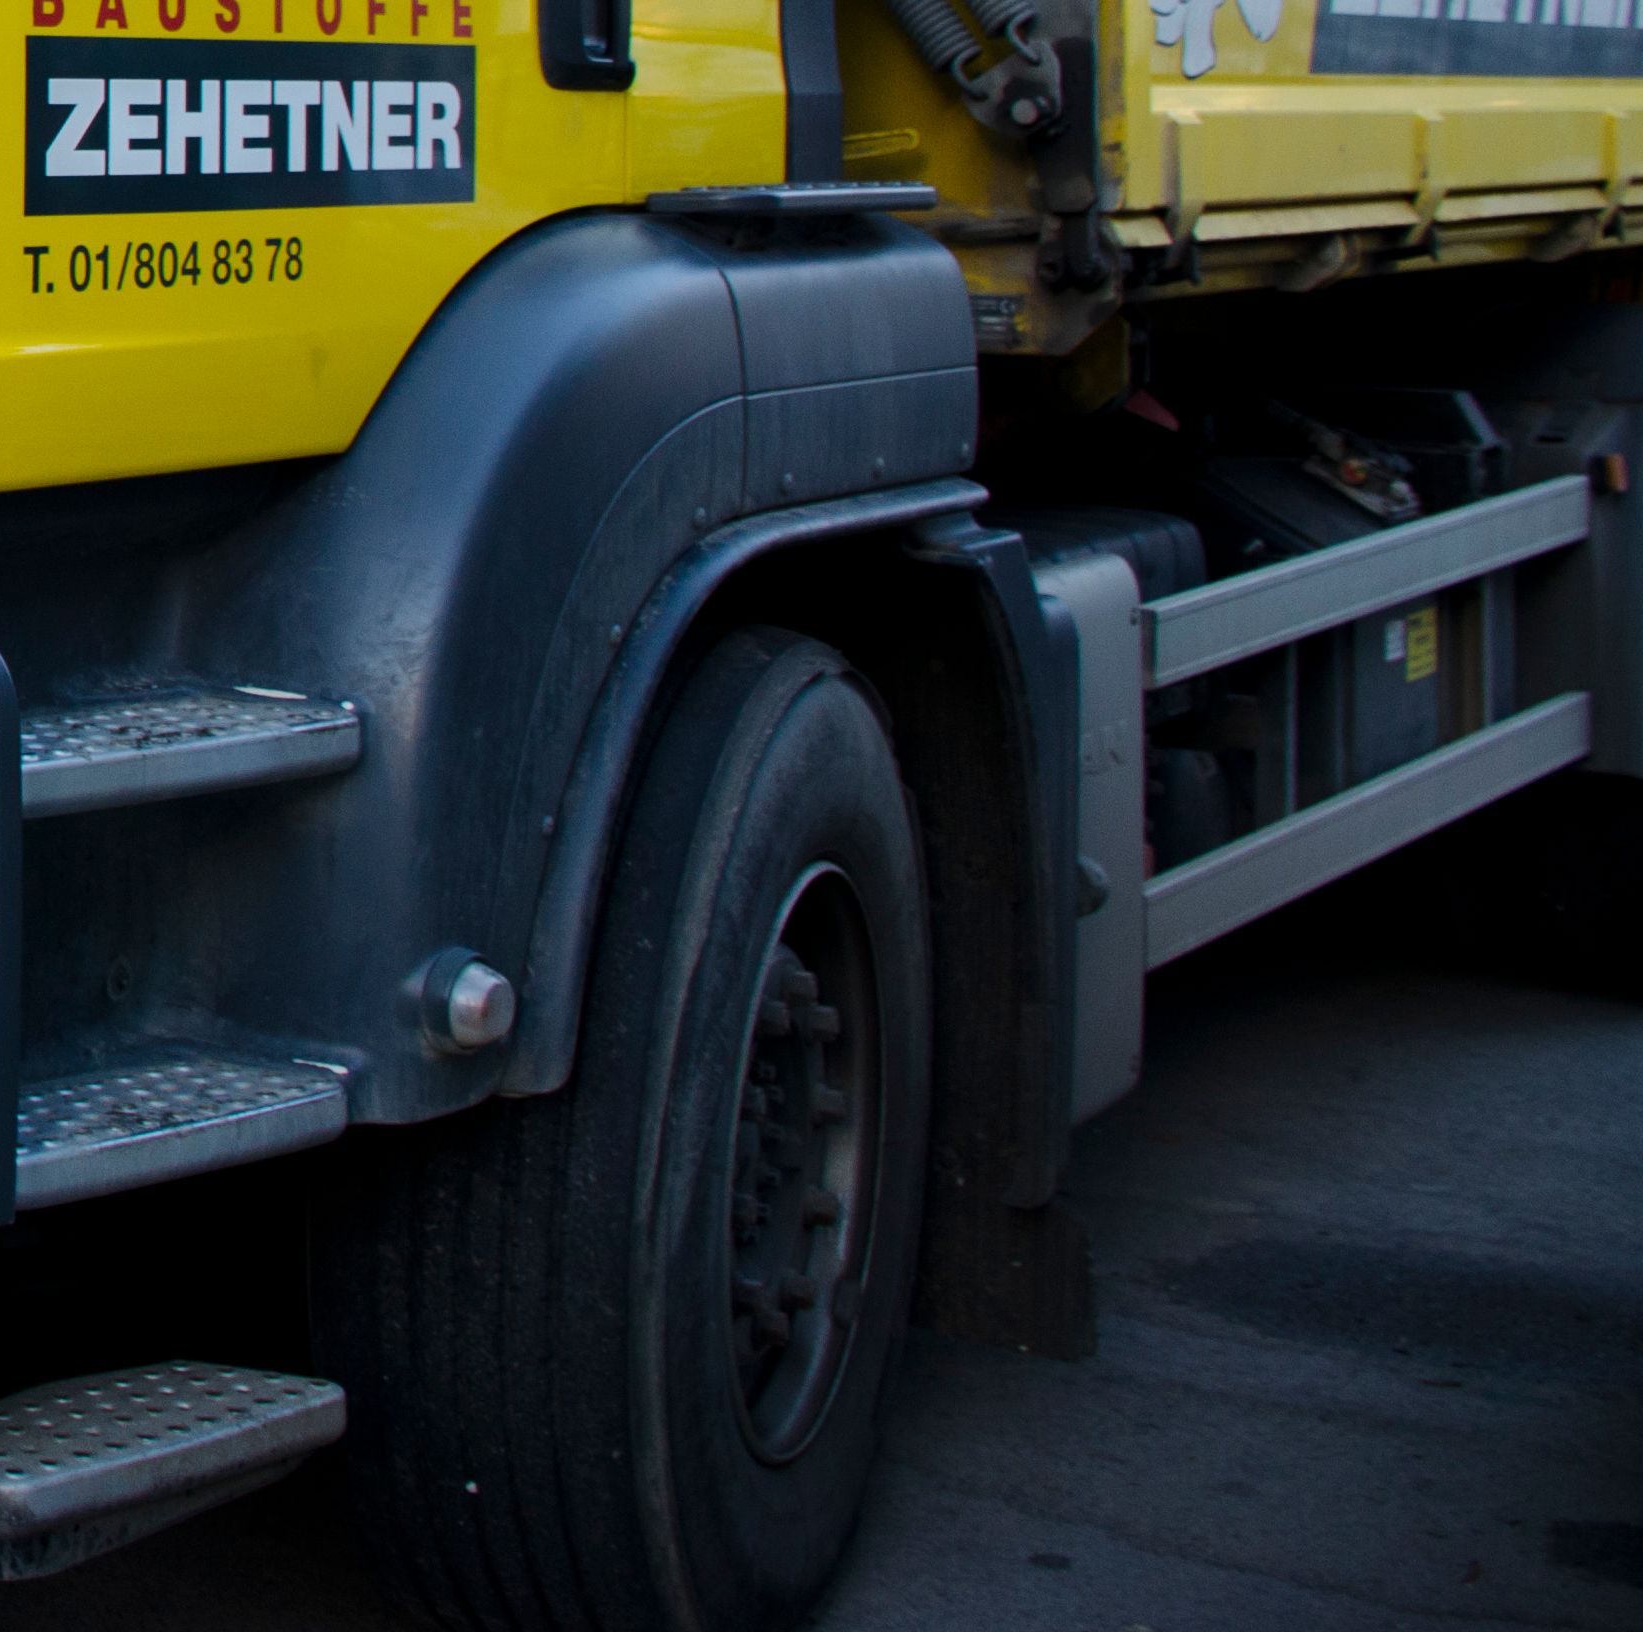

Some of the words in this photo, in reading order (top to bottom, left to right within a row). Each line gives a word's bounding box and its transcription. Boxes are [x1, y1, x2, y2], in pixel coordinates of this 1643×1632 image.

[44, 77, 463, 177] ZEHETNER
[23, 245, 55, 294] T.
[69, 240, 201, 293] 01/804
[212, 238, 254, 286] 83
[265, 235, 304, 282] 78
